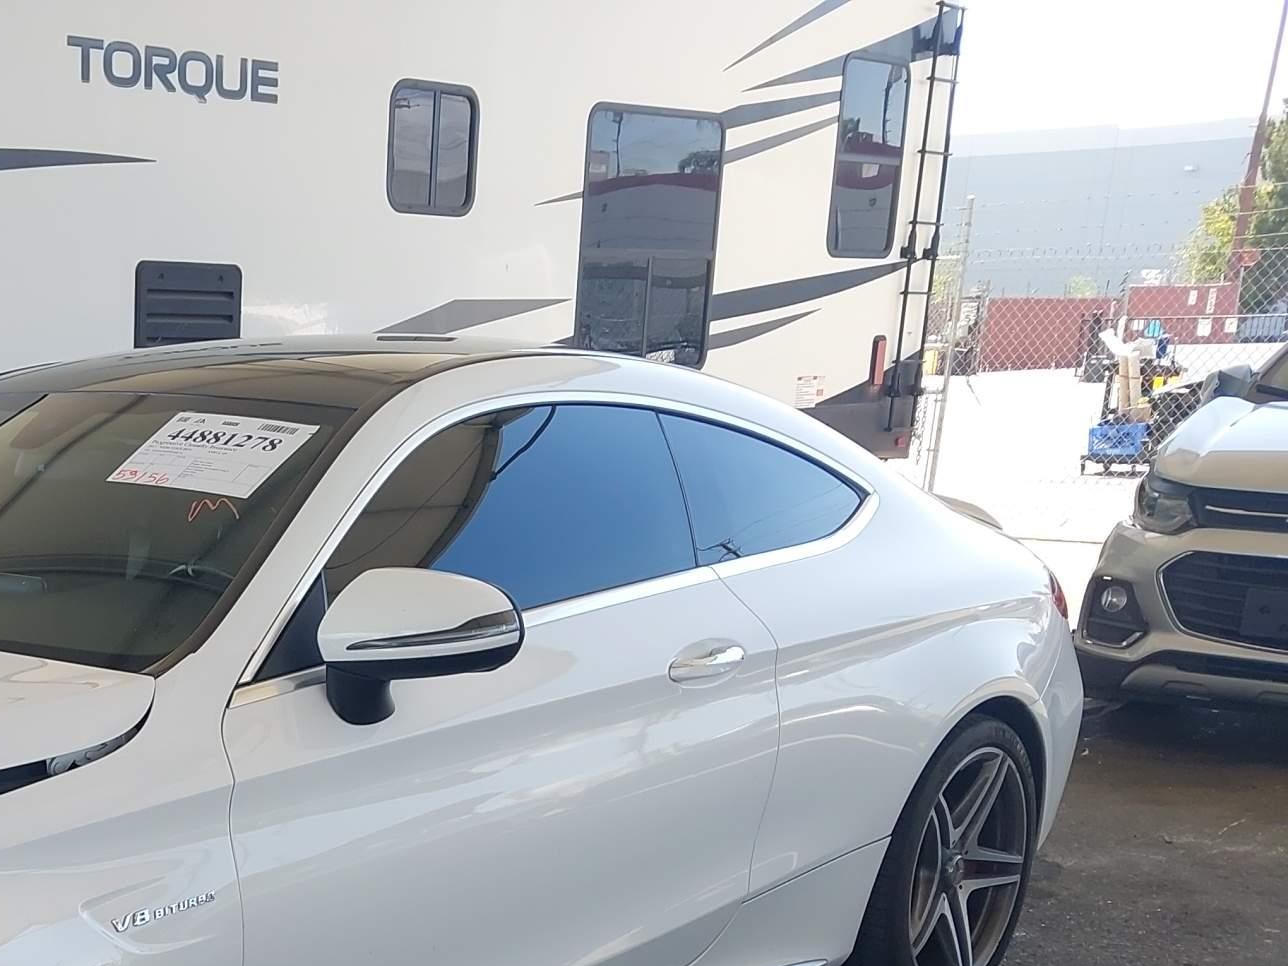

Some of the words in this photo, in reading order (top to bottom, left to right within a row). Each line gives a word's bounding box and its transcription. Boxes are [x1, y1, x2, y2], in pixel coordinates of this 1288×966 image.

[67, 34, 279, 104] TORQUE
[168, 427, 283, 452] 44881278
[111, 908, 151, 933] V8
[153, 890, 216, 921] BITURBO
